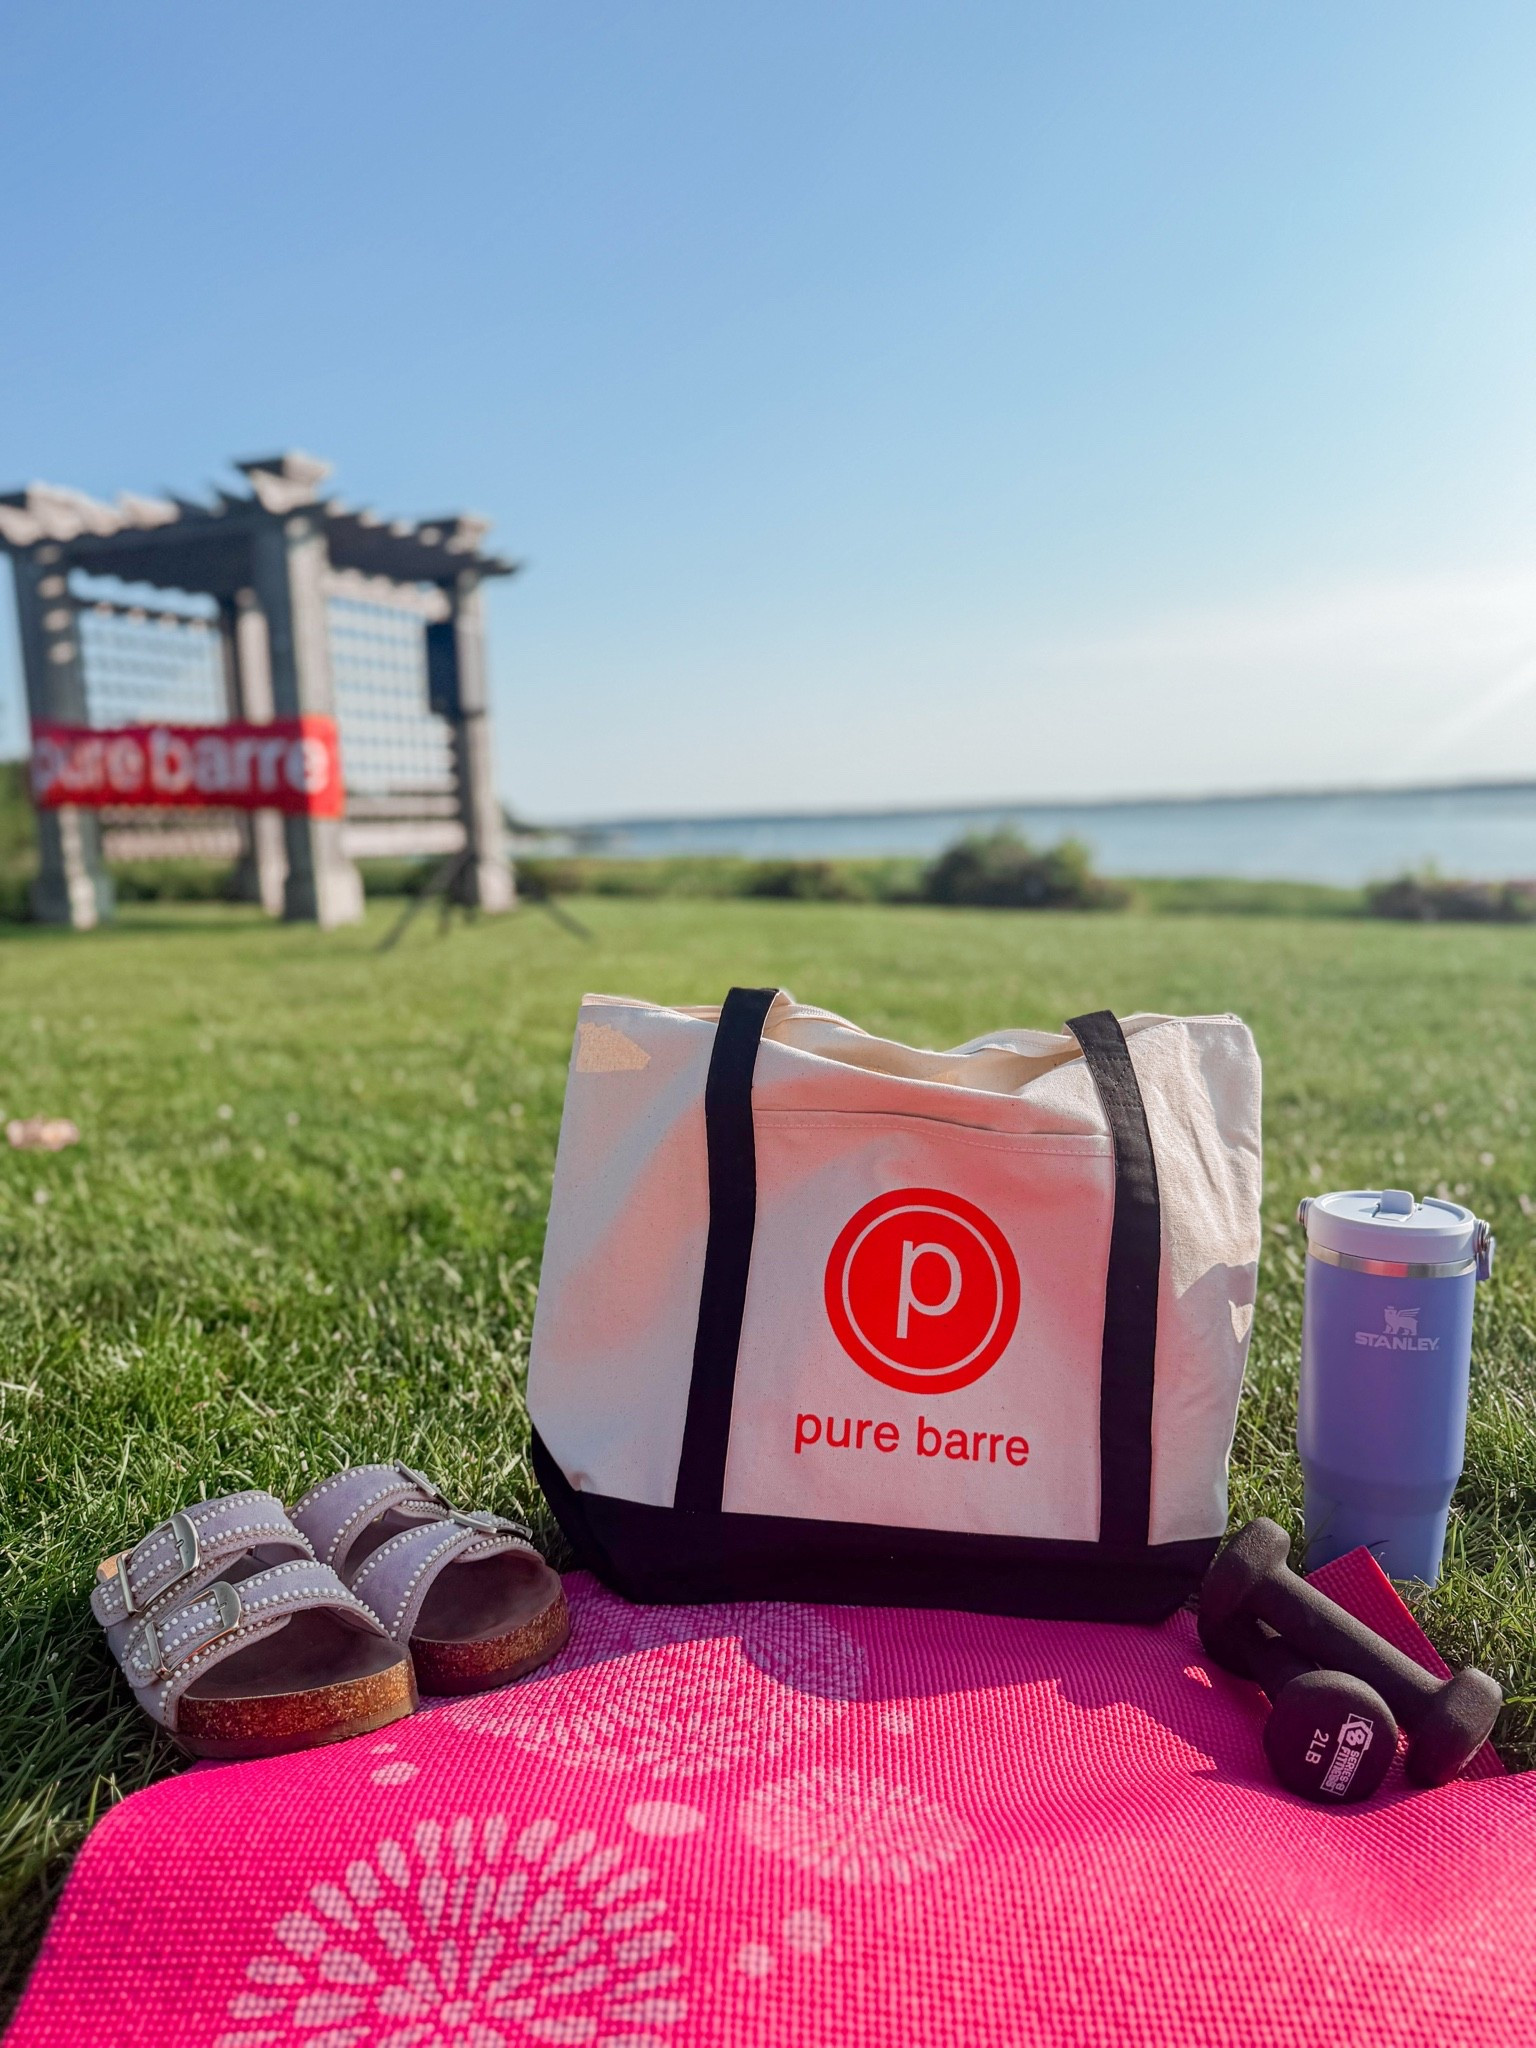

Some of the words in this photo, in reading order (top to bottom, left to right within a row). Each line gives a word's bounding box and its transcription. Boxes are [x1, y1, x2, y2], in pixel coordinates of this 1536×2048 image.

[150, 728, 330, 794] barre
[896, 1240, 962, 1339] p
[1355, 1331, 1440, 1351] STANLEY
[795, 1413, 900, 1454] pure
[917, 1416, 1030, 1467] barre
[1325, 1746, 1351, 1788] FITNESS
